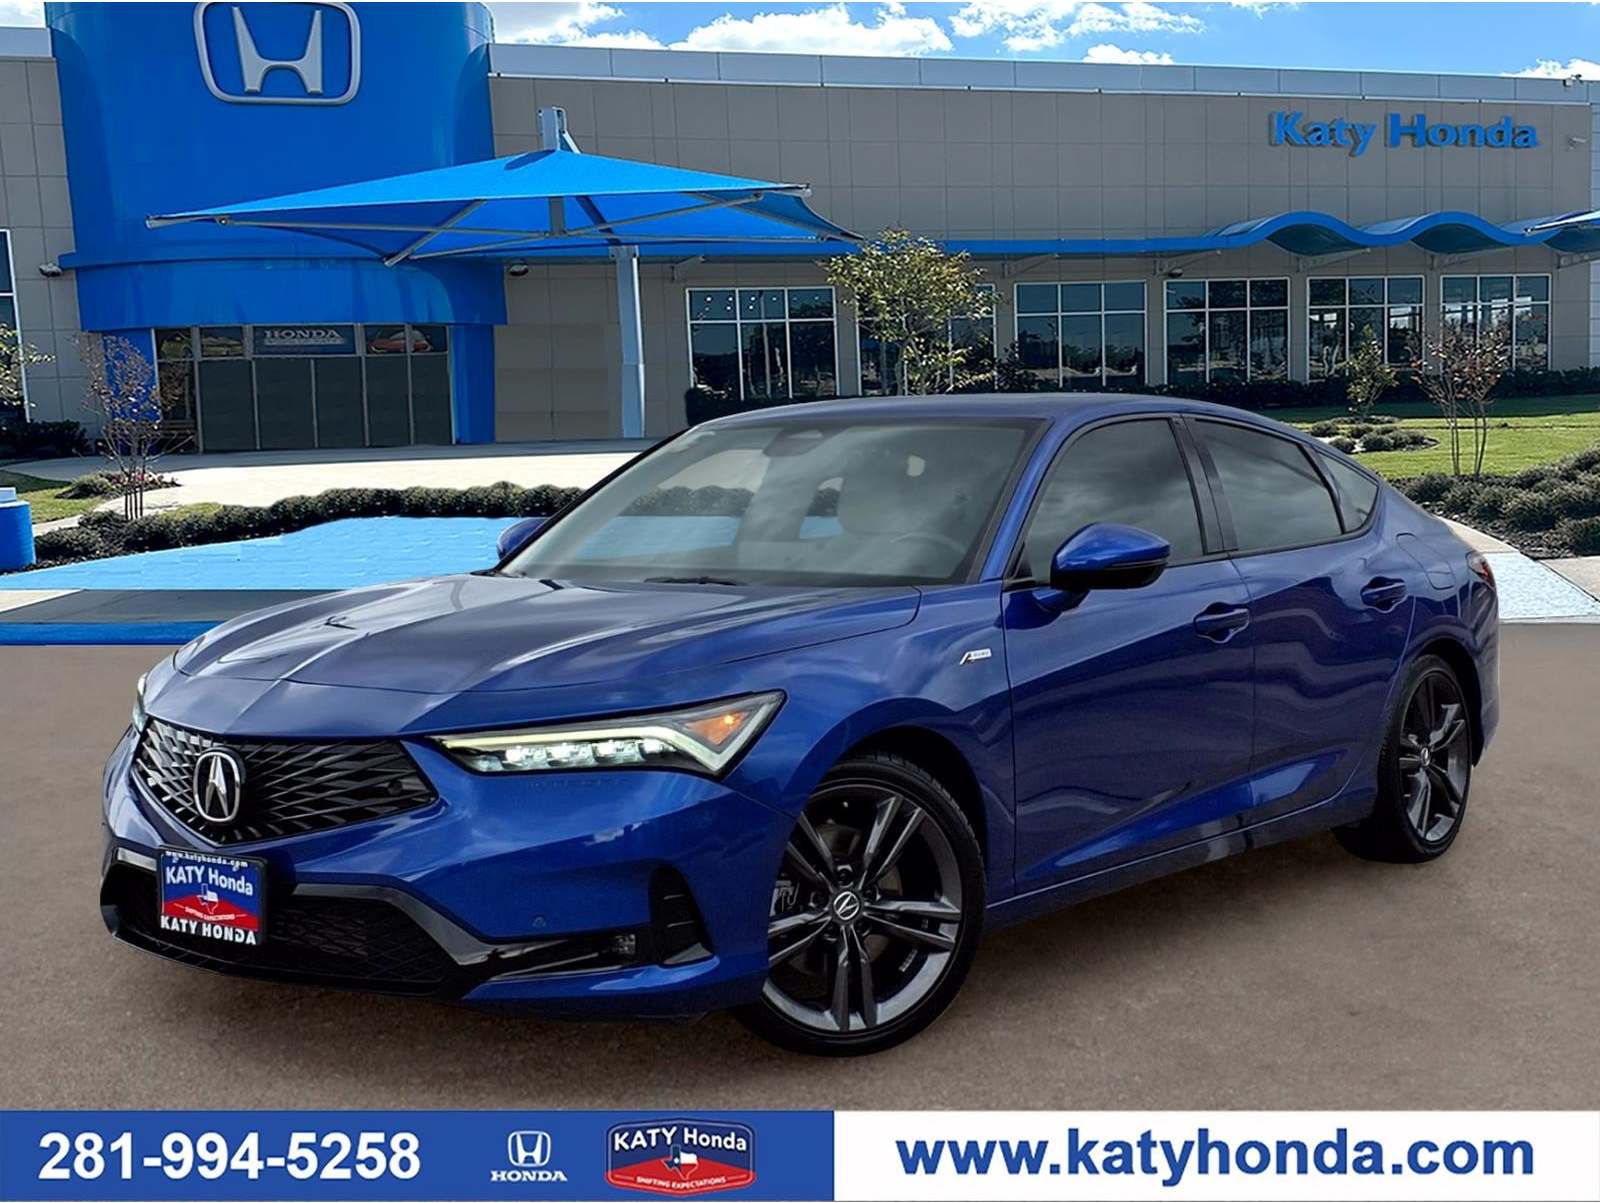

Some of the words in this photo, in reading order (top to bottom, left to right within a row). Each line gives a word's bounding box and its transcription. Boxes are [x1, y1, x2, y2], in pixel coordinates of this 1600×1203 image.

[1269, 111, 1377, 157] Katy
[1386, 112, 1541, 149] Honda
[264, 329, 341, 339] HONDA
[165, 865, 205, 884] KATY
[208, 867, 254, 896] Honda
[160, 915, 198, 934] KATY
[201, 922, 257, 945] HONDA
